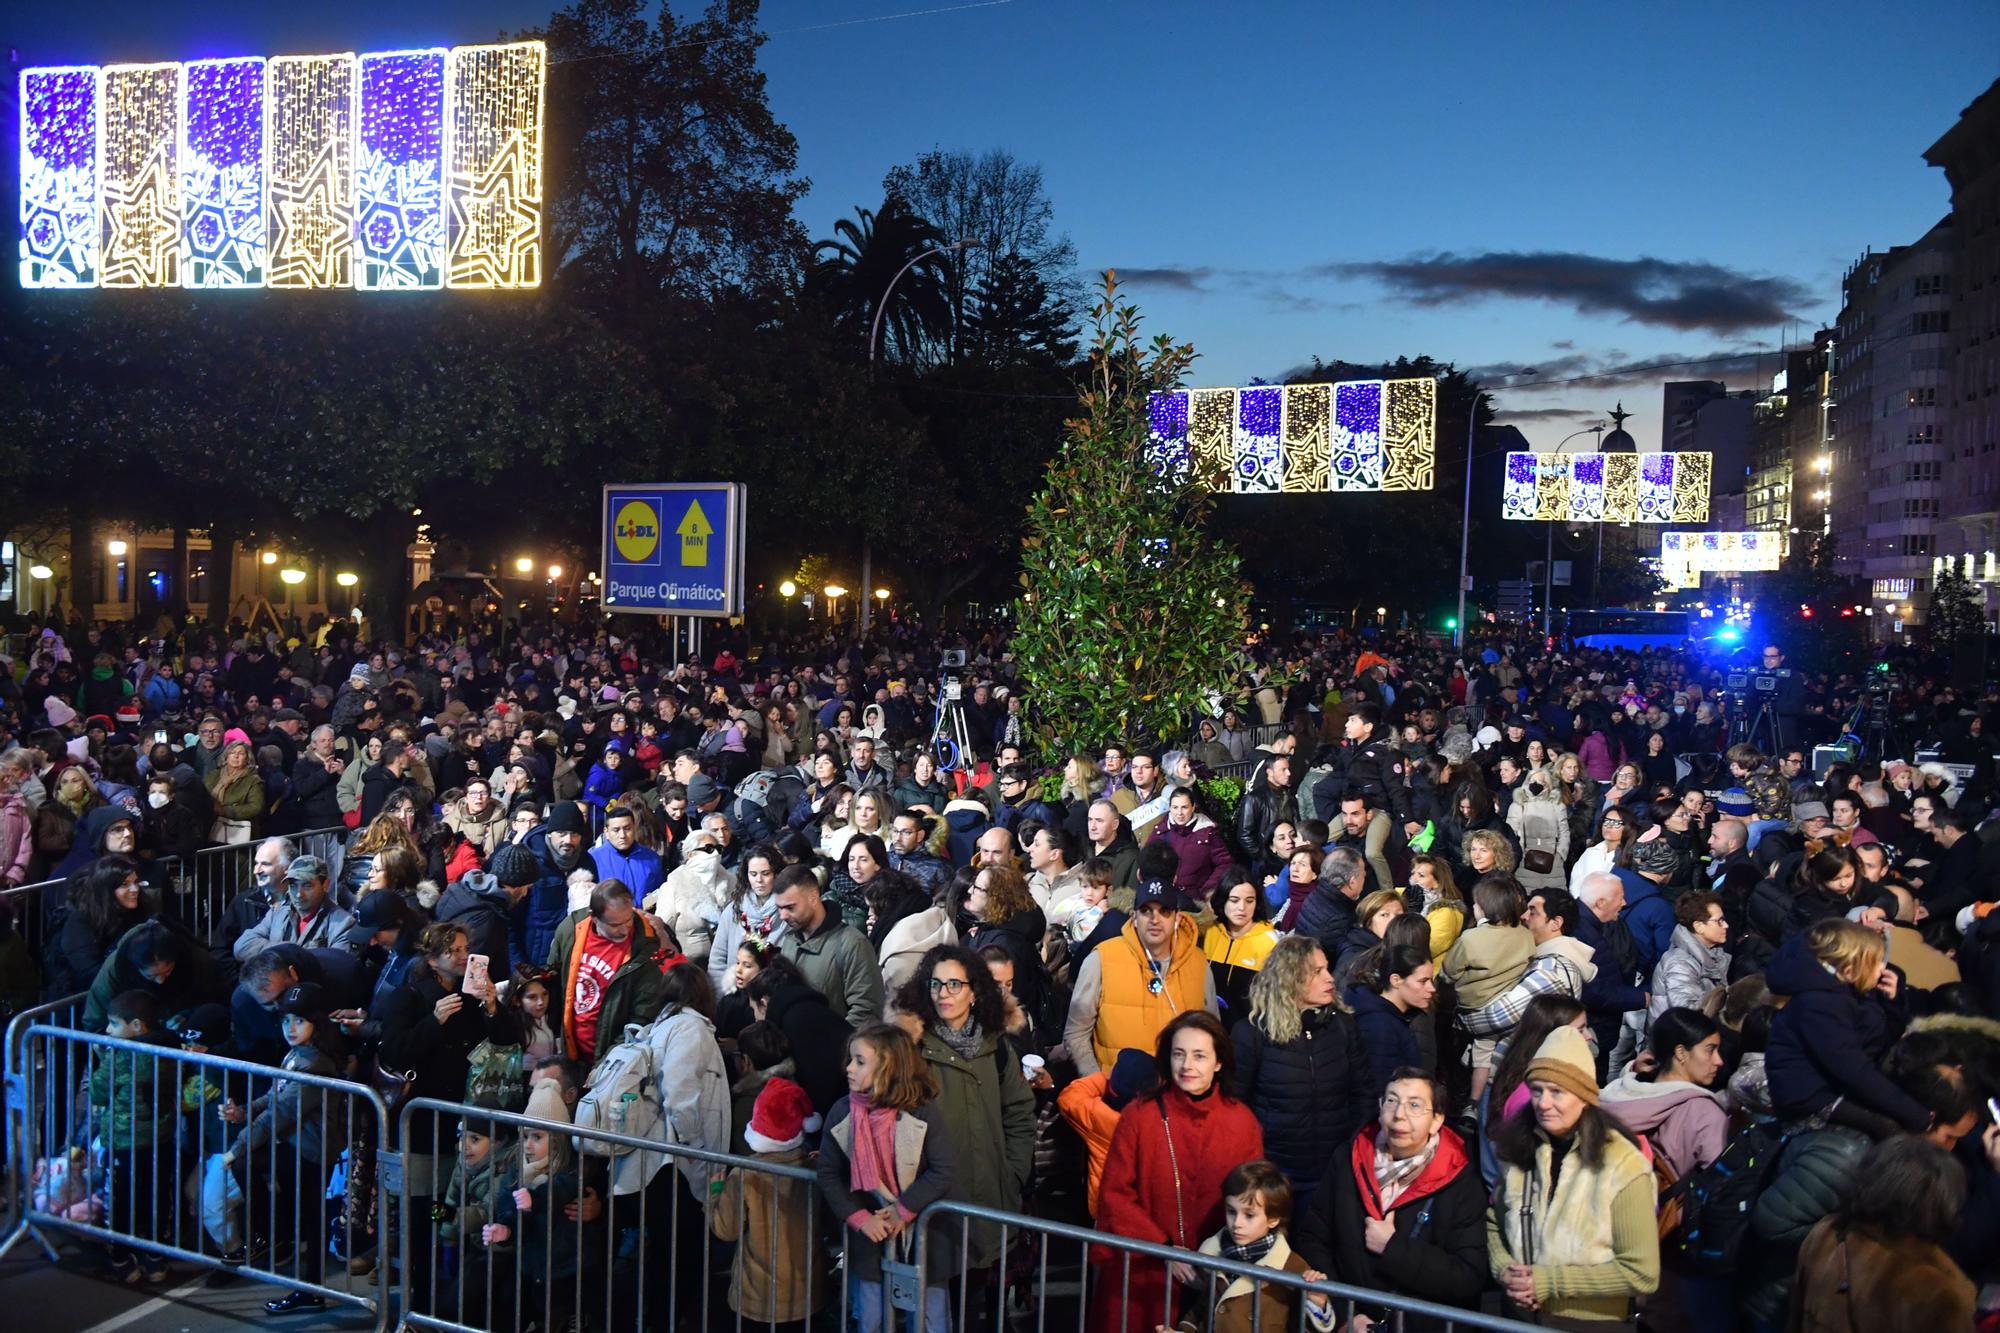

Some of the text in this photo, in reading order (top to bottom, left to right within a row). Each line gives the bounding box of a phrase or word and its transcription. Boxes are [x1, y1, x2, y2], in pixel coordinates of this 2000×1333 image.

[685, 535, 704, 547] MIN
[610, 581, 723, 602] Parque Ofimático
